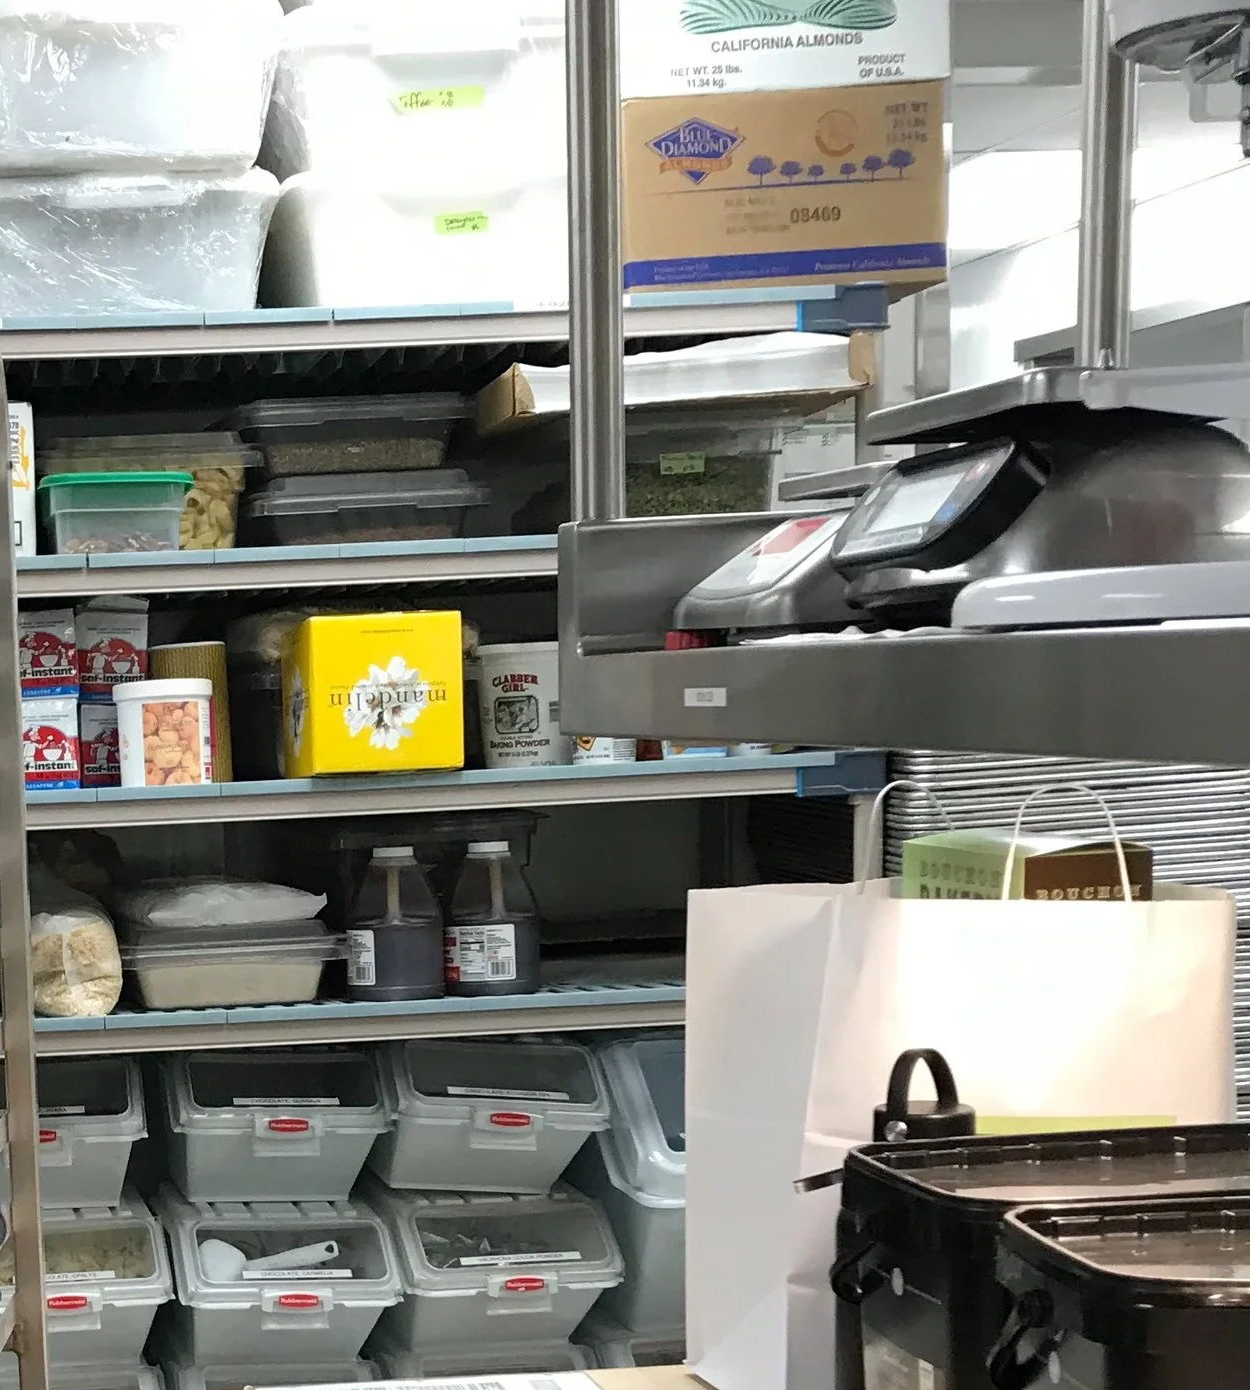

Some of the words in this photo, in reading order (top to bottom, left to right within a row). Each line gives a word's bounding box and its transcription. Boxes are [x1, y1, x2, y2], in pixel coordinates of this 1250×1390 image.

[711, 36, 793, 53] CALIFORNIA
[796, 32, 863, 48] ALMONDS
[858, 53, 906, 65] PRODUCT
[859, 68, 874, 78] OF
[875, 65, 905, 77] U.S.A.
[686, 78, 710, 88] 11.34
[679, 125, 712, 142] BLUE
[661, 137, 732, 156] DIAMOND
[790, 206, 841, 223] 08469
[20, 666, 74, 678] f-instant
[492, 673, 539, 687] CLABBER
[501, 684, 526, 693] GIRL
[330, 688, 447, 712] mandelin
[515, 739, 550, 748] POWDER
[1036, 884, 1142, 900] BOUCHON
